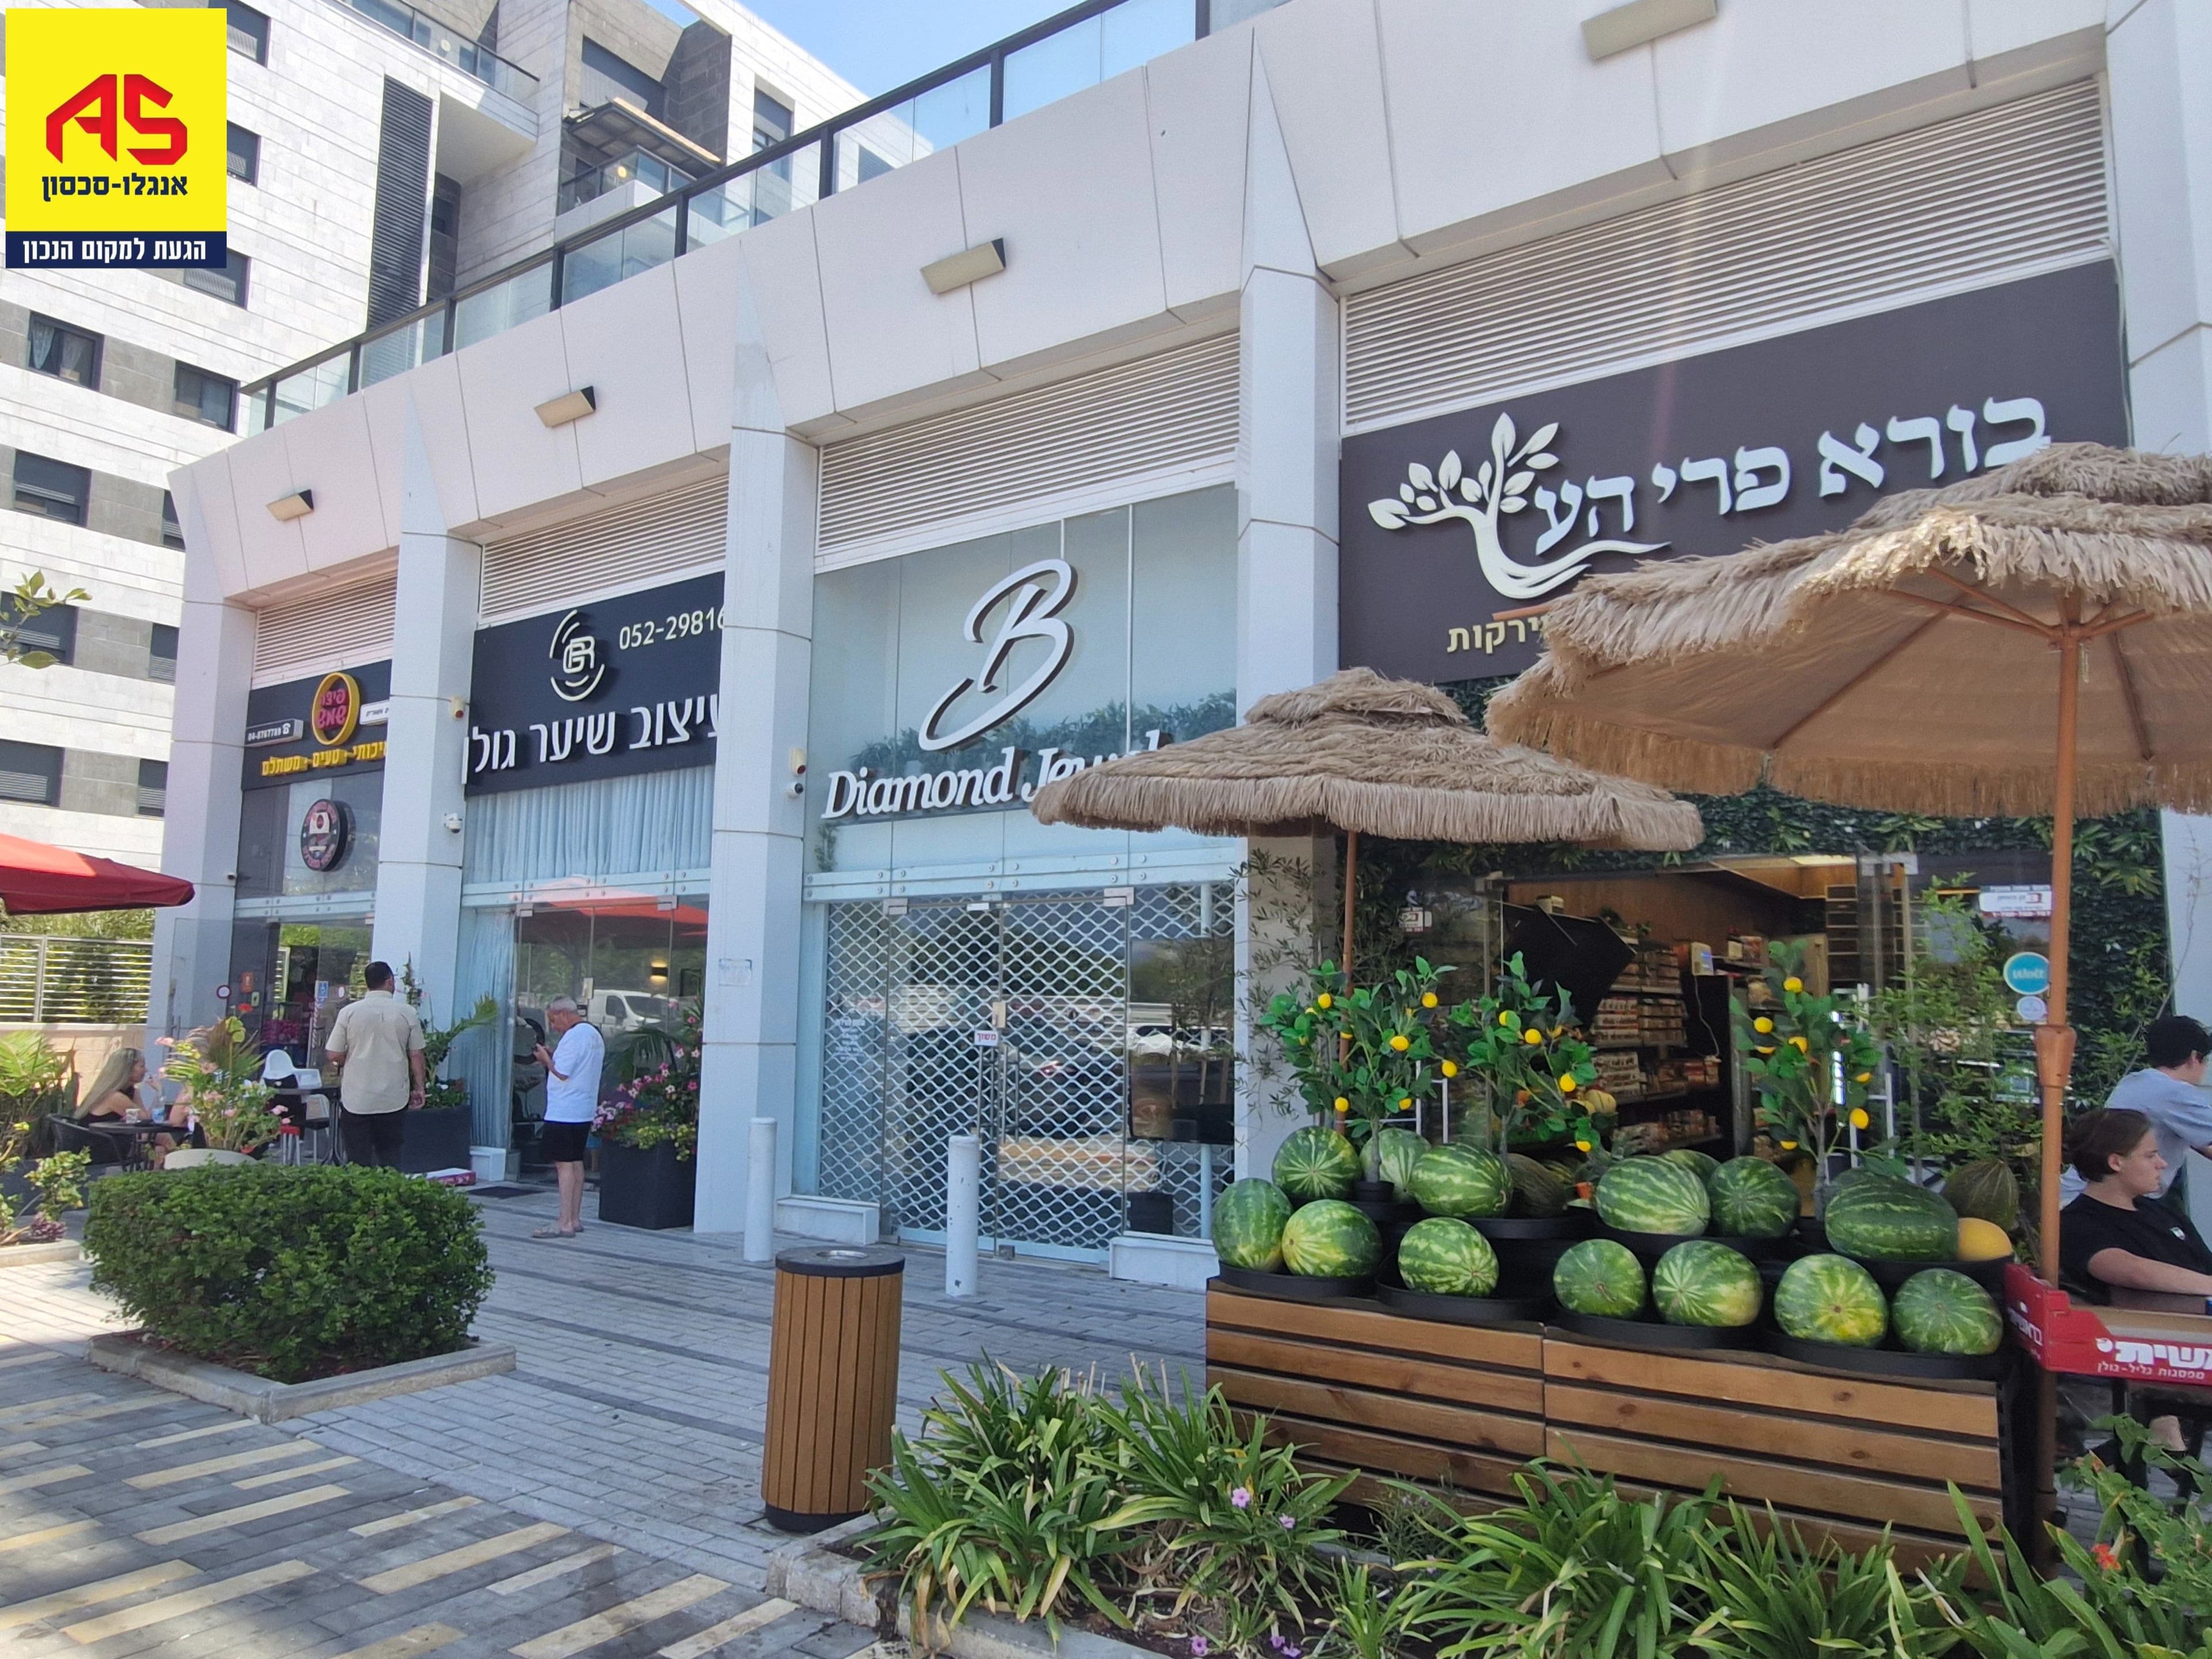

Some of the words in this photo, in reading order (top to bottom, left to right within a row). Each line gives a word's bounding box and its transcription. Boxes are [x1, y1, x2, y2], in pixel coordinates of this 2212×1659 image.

[1817, 397, 2051, 498] בורא
[1651, 445, 1790, 516] פרי
[918, 559, 1078, 751] B
[317, 704, 347, 729] שמש
[529, 711, 616, 763] שיער
[262, 756, 303, 776] משתלם
[313, 749, 343, 767] טעים
[461, 726, 516, 785] גולן
[821, 746, 1015, 819] Diamond
